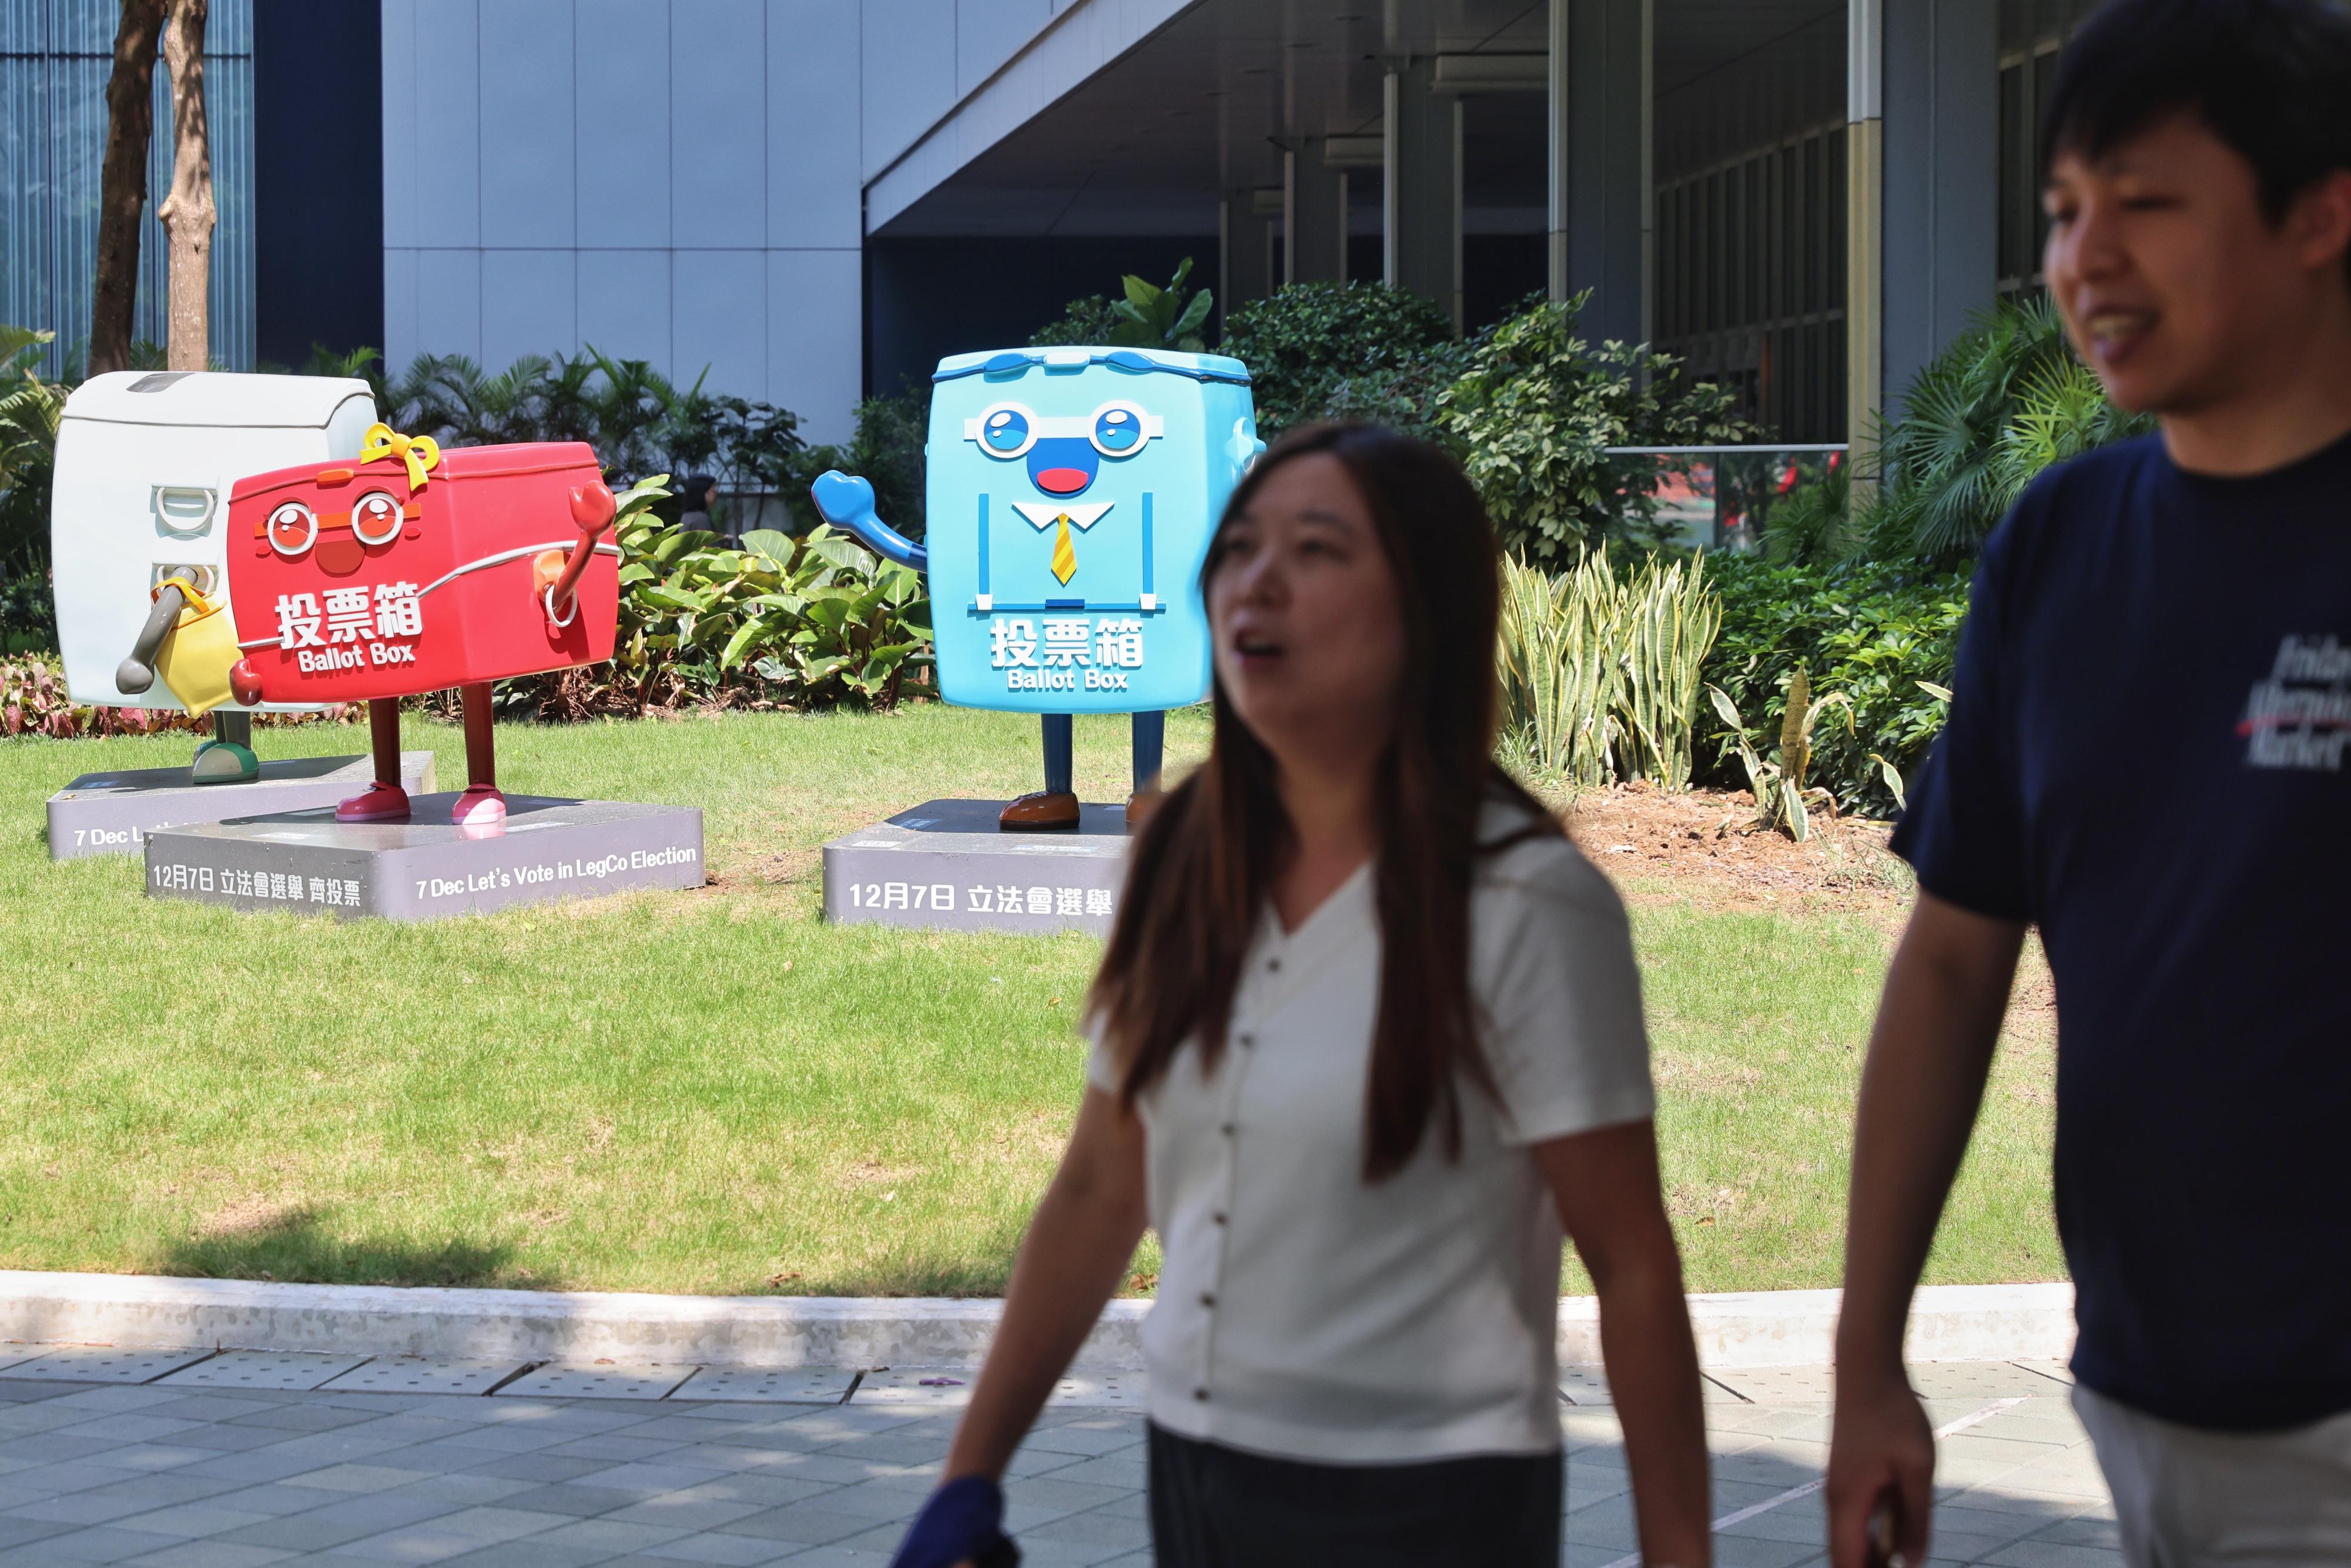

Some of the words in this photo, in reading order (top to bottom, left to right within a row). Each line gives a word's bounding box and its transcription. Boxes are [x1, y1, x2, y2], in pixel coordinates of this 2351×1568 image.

[275, 581, 423, 649] 投票箱
[298, 645, 365, 672] Ballot
[370, 643, 416, 665] Box
[990, 619, 1143, 667] 投票箱
[1007, 669, 1075, 688] Ballot
[1085, 669, 1128, 688] Box
[74, 830, 86, 846] 7
[91, 829, 128, 845] Dec
[154, 865, 214, 892] 12月7日
[220, 869, 303, 901] 立法會選舉
[309, 877, 360, 906] 齊投票
[416, 880, 427, 899] 7
[431, 878, 464, 898] Dec
[468, 867, 511, 892] Let's
[514, 864, 554, 886] Vote
[558, 861, 574, 879] in
[577, 854, 628, 879] LegCo
[631, 846, 696, 870] Election
[850, 882, 955, 910] 12月7日
[967, 884, 1113, 916] 立法會選舉
